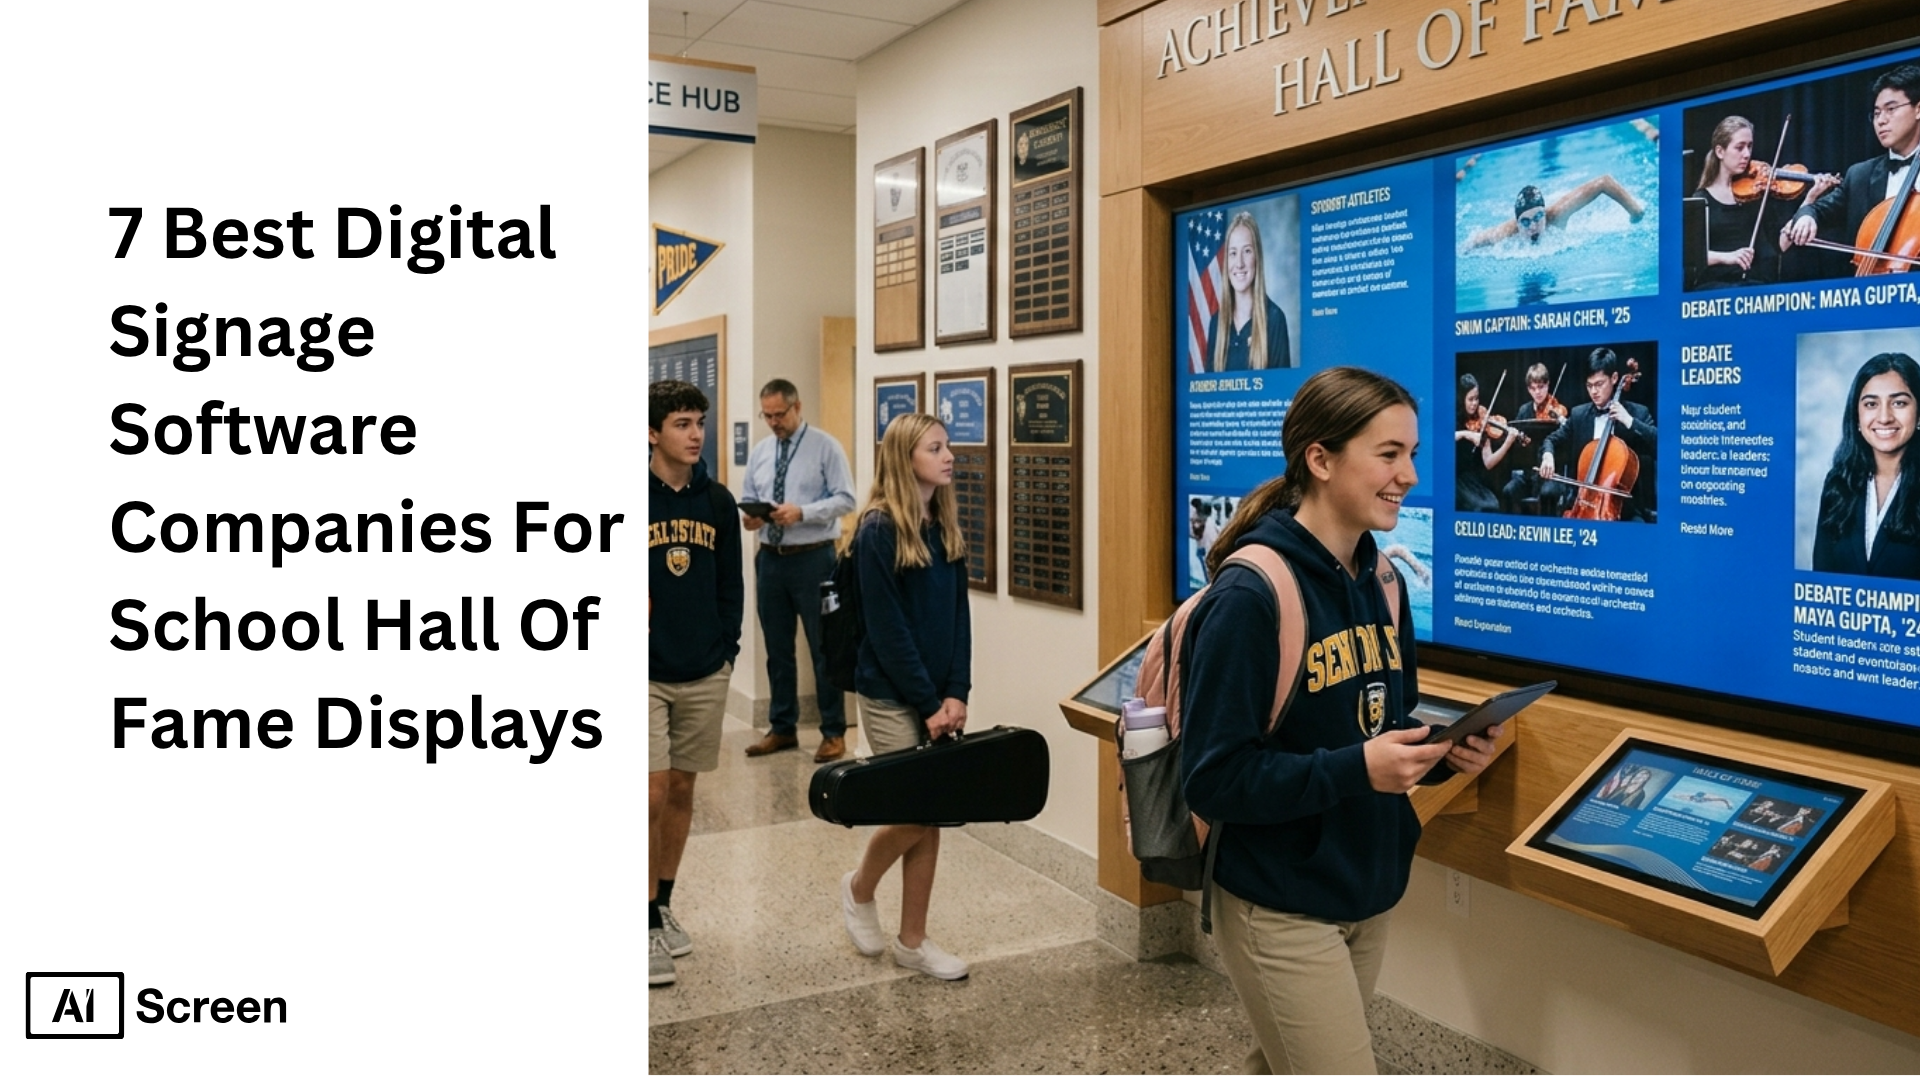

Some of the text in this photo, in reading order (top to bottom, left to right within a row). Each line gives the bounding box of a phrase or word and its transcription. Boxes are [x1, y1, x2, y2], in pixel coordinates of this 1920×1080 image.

[1273, 0, 1678, 116] HALL OF FA
[682, 84, 740, 113] HUB
[657, 242, 697, 290] PRIDE
[1682, 298, 1731, 319] DEBATE
[1735, 291, 1816, 315] CHAMPION:
[1820, 287, 1861, 308] MAYA
[1484, 315, 1531, 334] CAPTAIN:
[1534, 311, 1571, 329] SARAH
[1573, 308, 1608, 328] CHEN,
[1611, 306, 1631, 324] '25
[1681, 344, 1733, 364] DEBATE
[1681, 367, 1742, 386] LEADERS
[1454, 520, 1598, 548] CELLO LEAD: REVIN LEE, '24
[1709, 523, 1734, 536] More
[1794, 583, 1852, 606] DEBATE
[1794, 605, 1836, 628] MAYA
[1839, 611, 1897, 638] GUPTA,
[1793, 629, 1835, 646] Student
[1834, 653, 1856, 664] and
[1833, 669, 1854, 680] and
